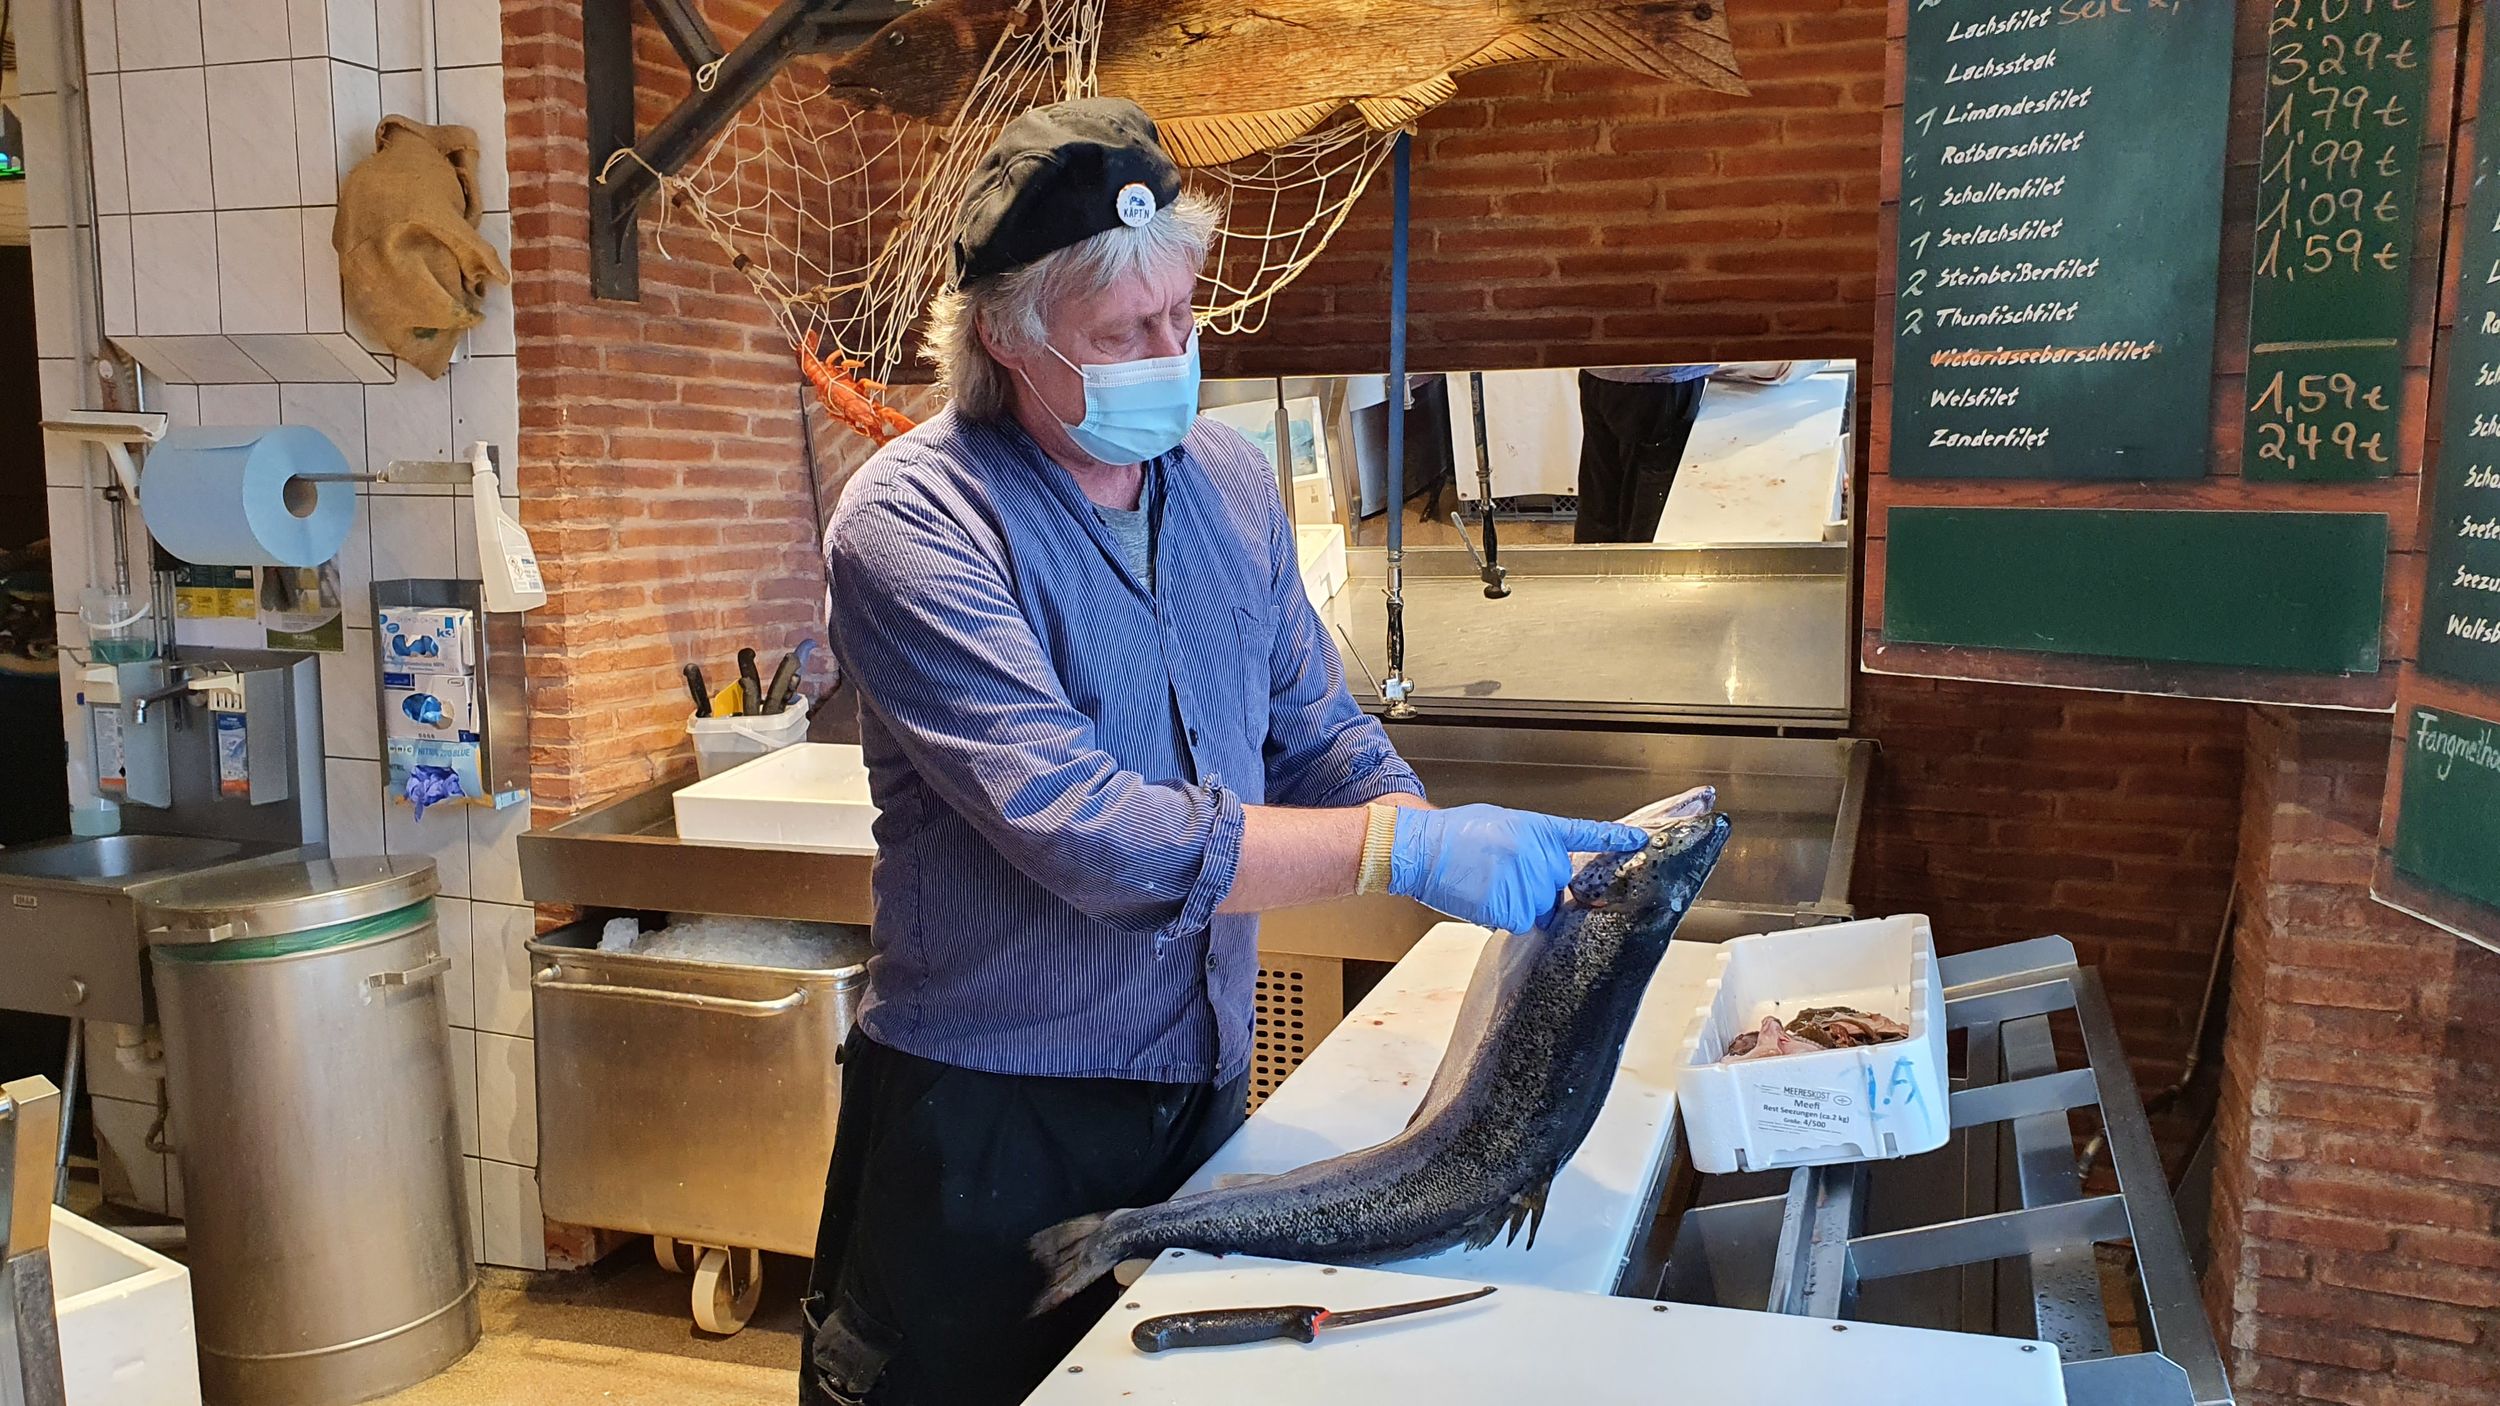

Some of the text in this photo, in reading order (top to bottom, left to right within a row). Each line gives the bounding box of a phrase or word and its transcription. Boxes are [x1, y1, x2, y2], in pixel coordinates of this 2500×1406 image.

[1946, 6, 2052, 43] Lachsfilet
[1944, 48, 2057, 84] Lachssteak
[1942, 86, 2094, 126] Limandesfilet
[1937, 218, 2064, 248] Seelachsfilet
[1901, 257, 2100, 298] 2 Steinbeißerfilet
[1901, 301, 2079, 337] 2 Thunfischfilet
[1929, 386, 2020, 408] Welsfilet
[1928, 426, 2050, 449] Zanderfilet
[2458, 515, 2500, 540] Seete
[2452, 564, 2500, 593] Seezu
[2416, 711, 2500, 781] Fangmetho
[1763, 1103, 1779, 1113] Rest
[1783, 1086, 1831, 1101] MEERESKOST
[1802, 1119, 1826, 1129] 4/500
